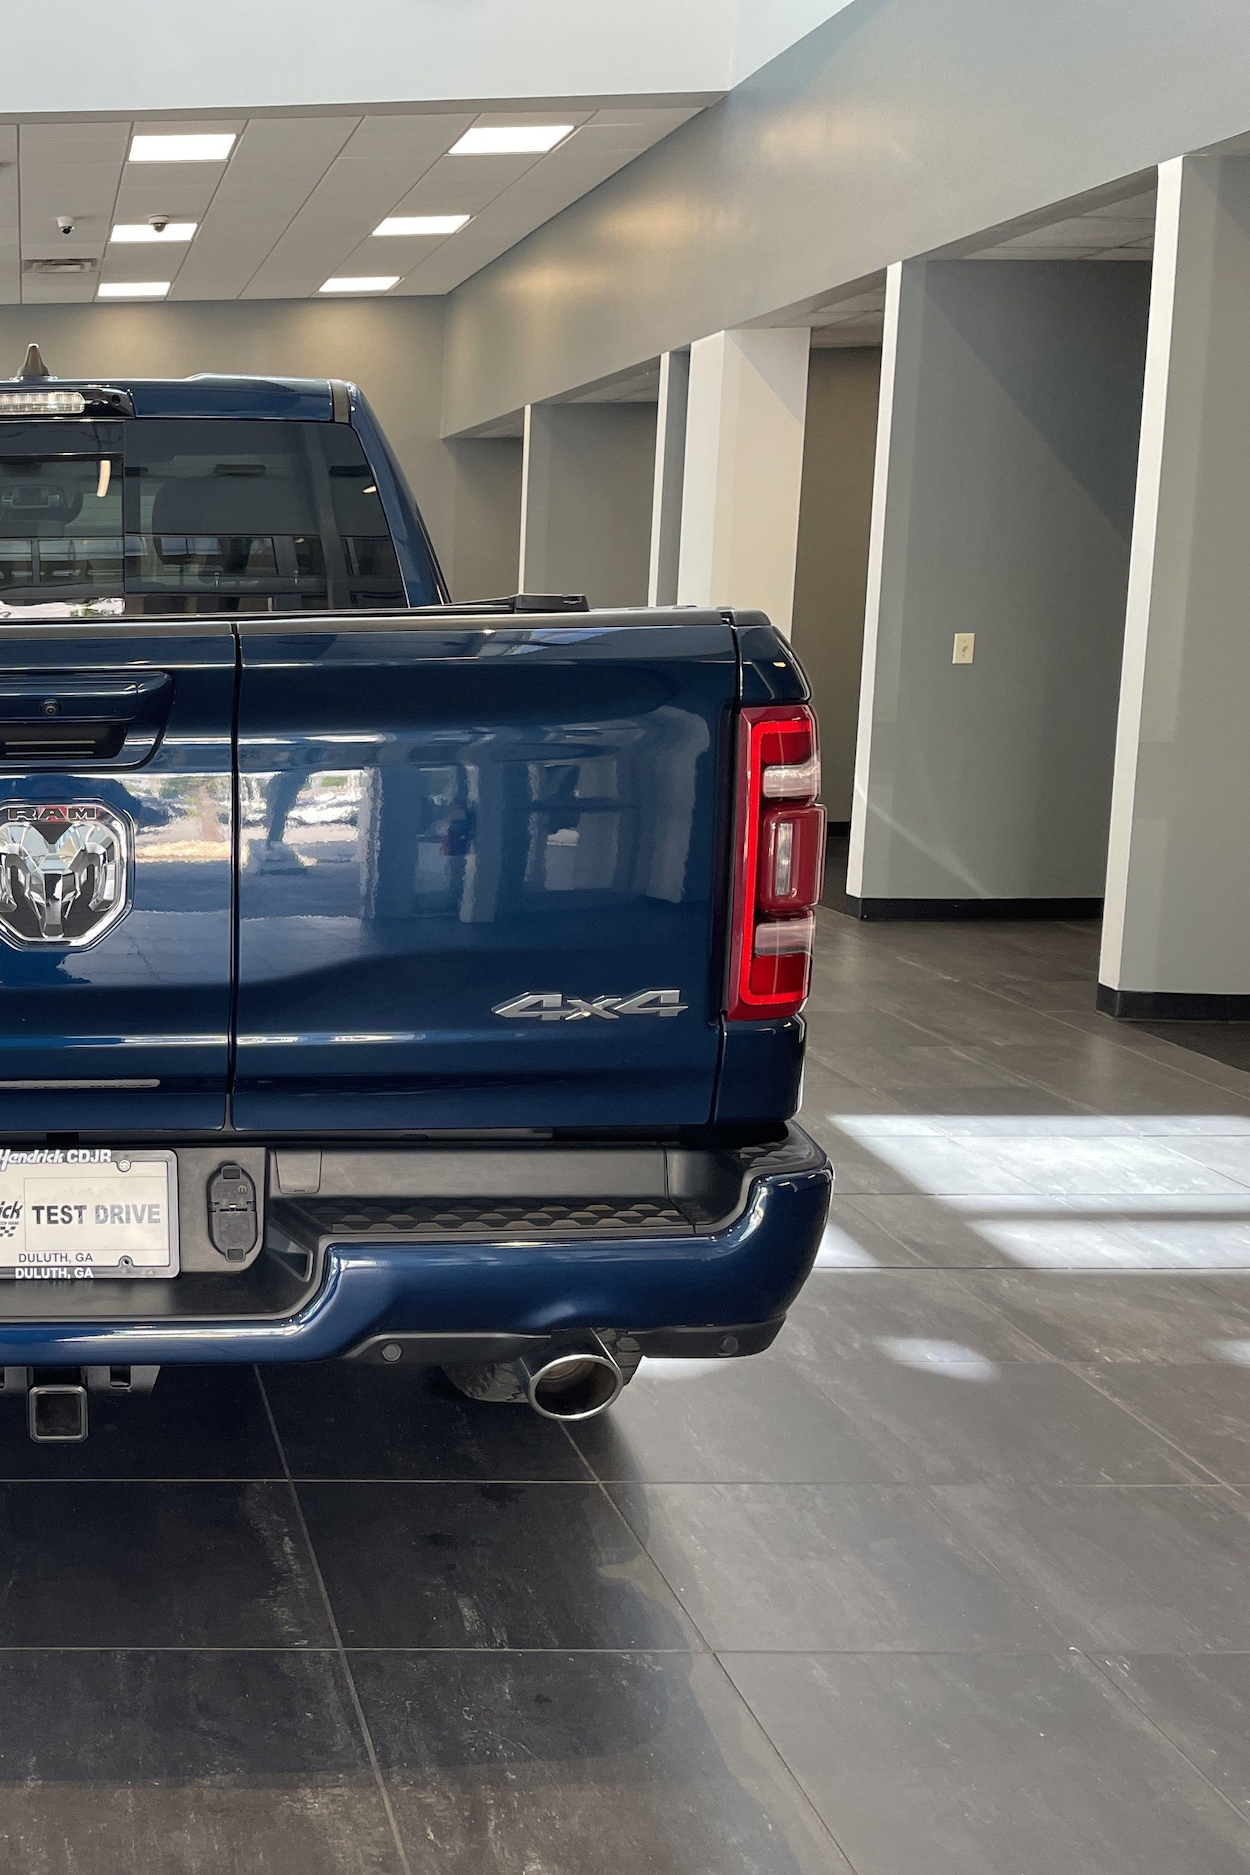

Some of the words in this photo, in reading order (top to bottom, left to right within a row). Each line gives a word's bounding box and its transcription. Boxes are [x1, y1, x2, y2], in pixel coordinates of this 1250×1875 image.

[8, 807, 97, 821] RAM
[491, 989, 689, 1021] 4x4
[67, 1150, 112, 1163] CDJR
[32, 1205, 87, 1225] TEST
[95, 1204, 161, 1225] DRIVE
[19, 1253, 71, 1264] DULUTH,
[75, 1252, 94, 1262] GA
[15, 1268, 70, 1279] DULUTH,
[74, 1267, 94, 1278] GA
